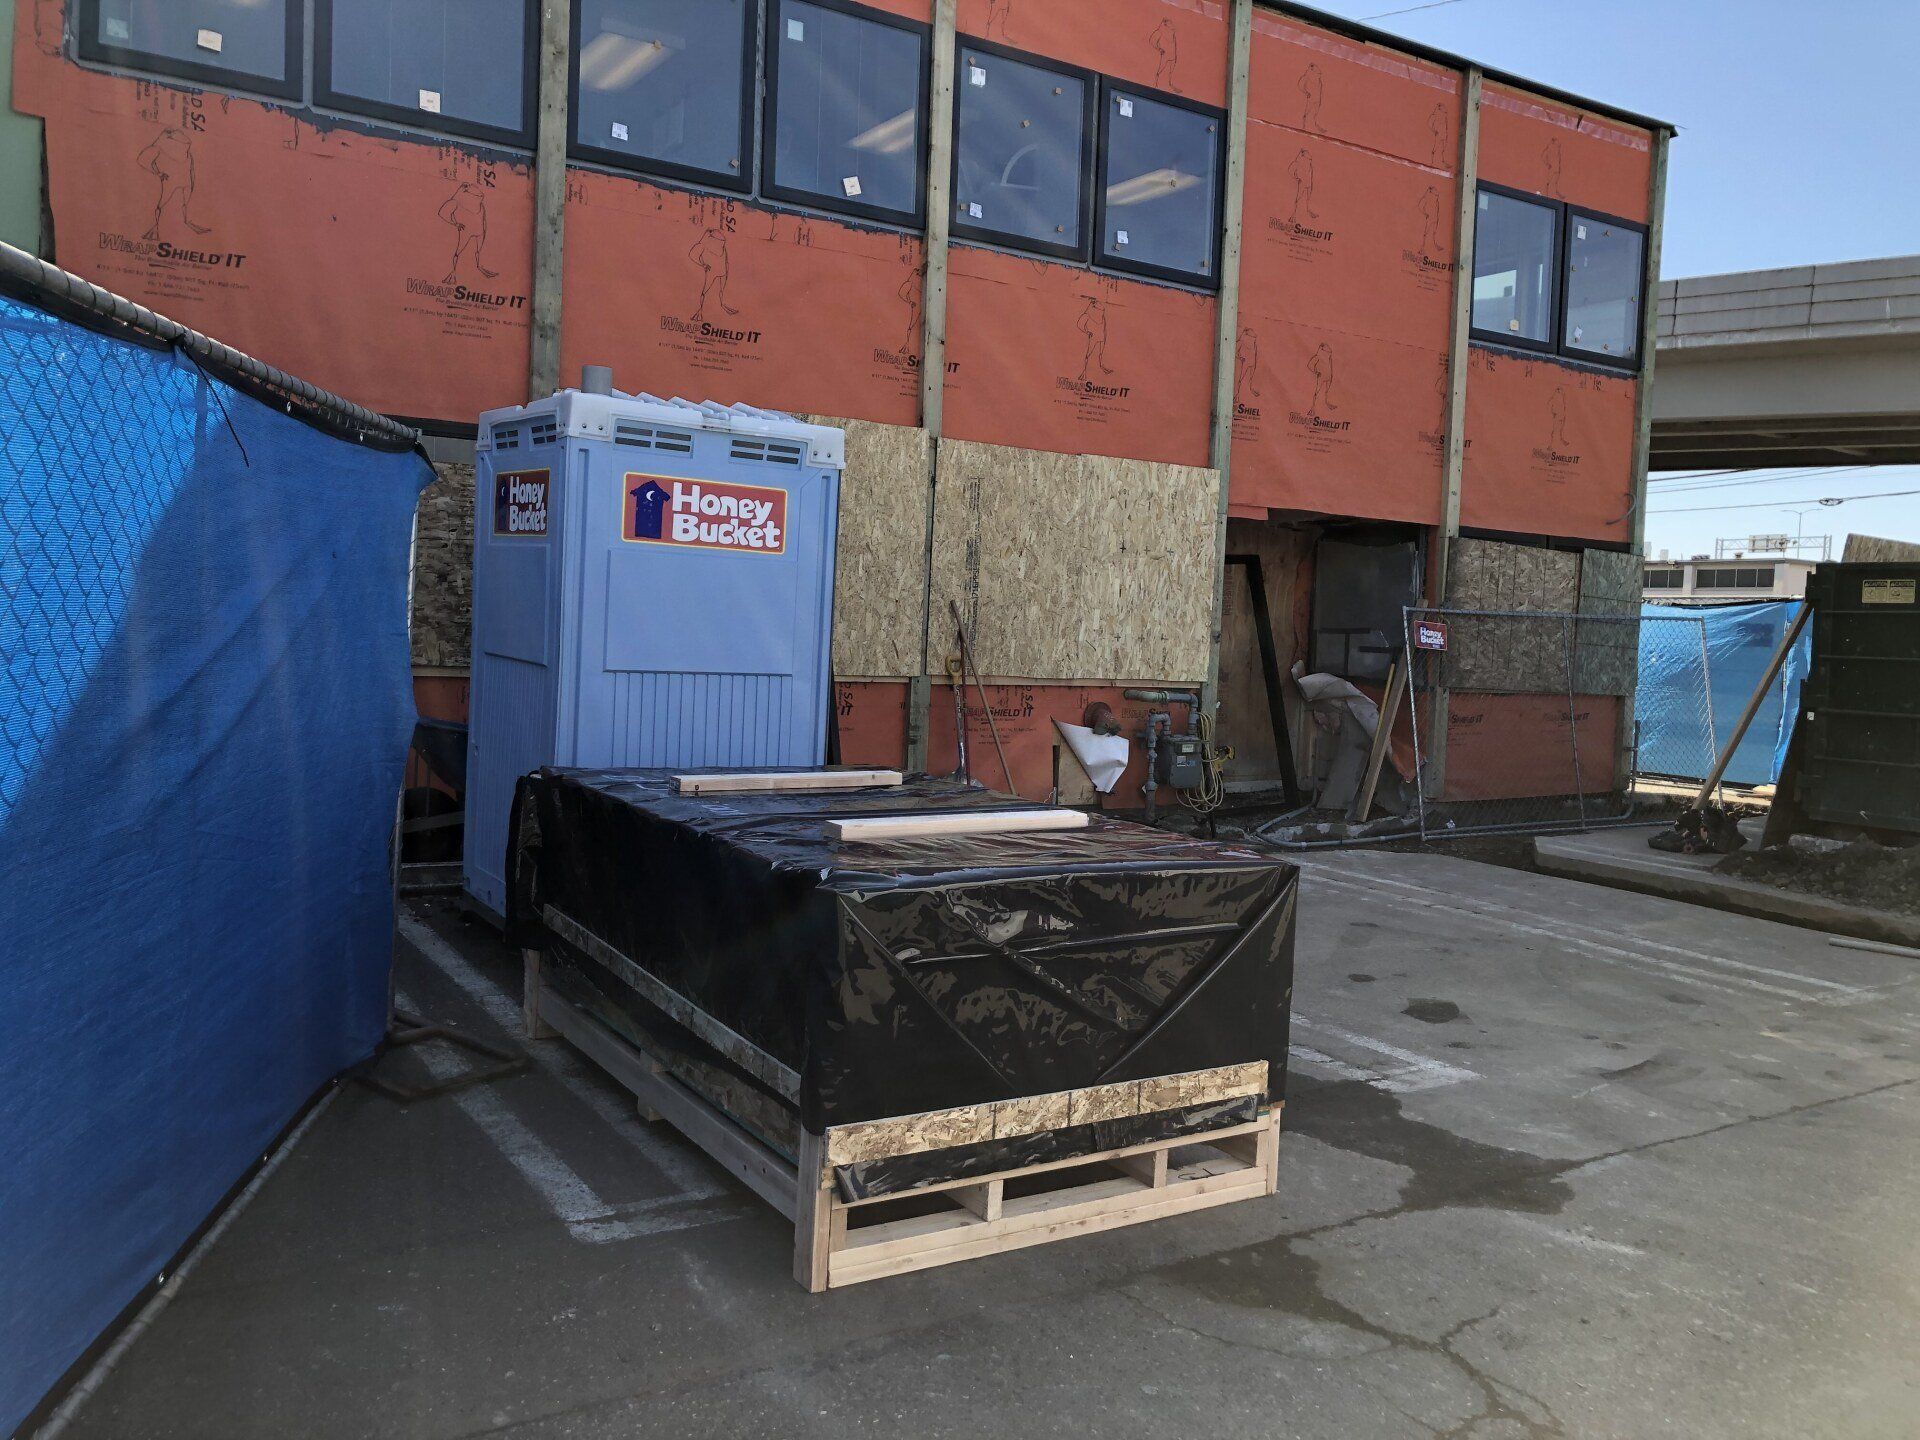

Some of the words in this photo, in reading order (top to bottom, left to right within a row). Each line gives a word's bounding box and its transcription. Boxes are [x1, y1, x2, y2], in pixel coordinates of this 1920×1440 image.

[1324, 231, 1333, 241] IT
[225, 253, 246, 268] IT
[510, 295, 526, 309] IT
[747, 331, 761, 343] IT
[947, 362, 960, 373] IT
[1119, 387, 1130, 398] IT
[1341, 421, 1350, 431] IT
[509, 475, 545, 510] Honey
[672, 482, 774, 526] Honey
[509, 502, 547, 532] Bucket
[671, 513, 781, 548] Bucket
[1420, 626, 1442, 639] Honey
[1420, 635, 1445, 645] Bucket
